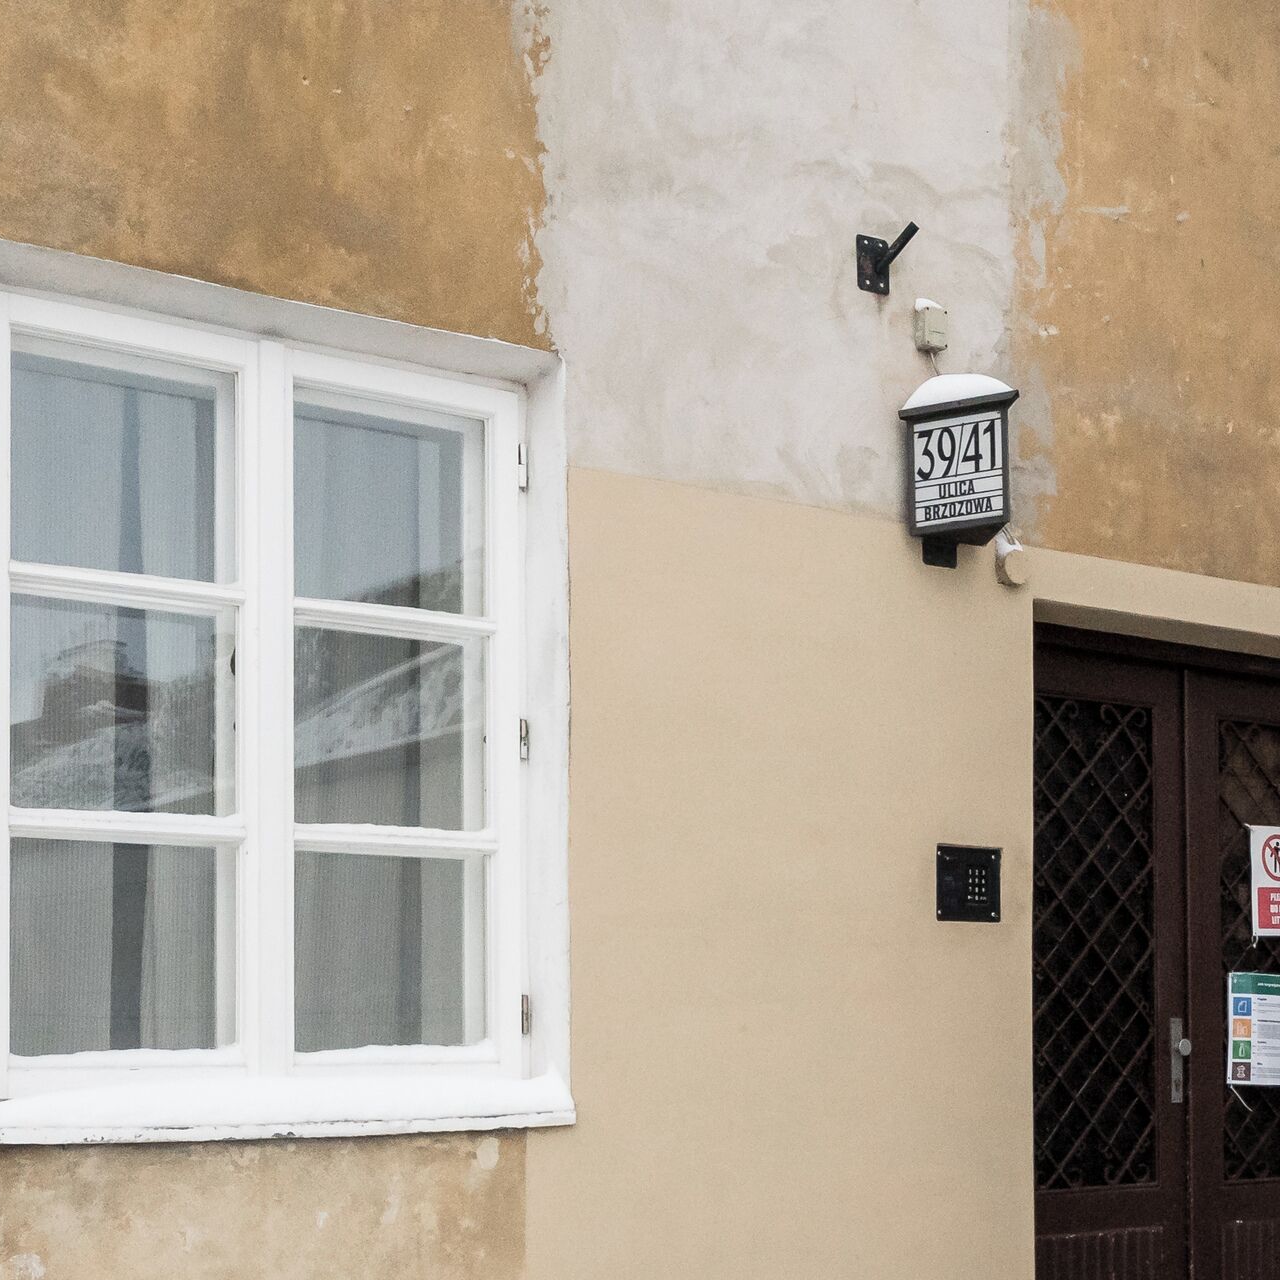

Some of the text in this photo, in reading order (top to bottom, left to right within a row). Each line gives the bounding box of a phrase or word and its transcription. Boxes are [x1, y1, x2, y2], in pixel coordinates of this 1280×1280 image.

[916, 420, 996, 481] 39/41
[938, 480, 975, 499] ULICA
[924, 499, 993, 521] BRZOZOWA
